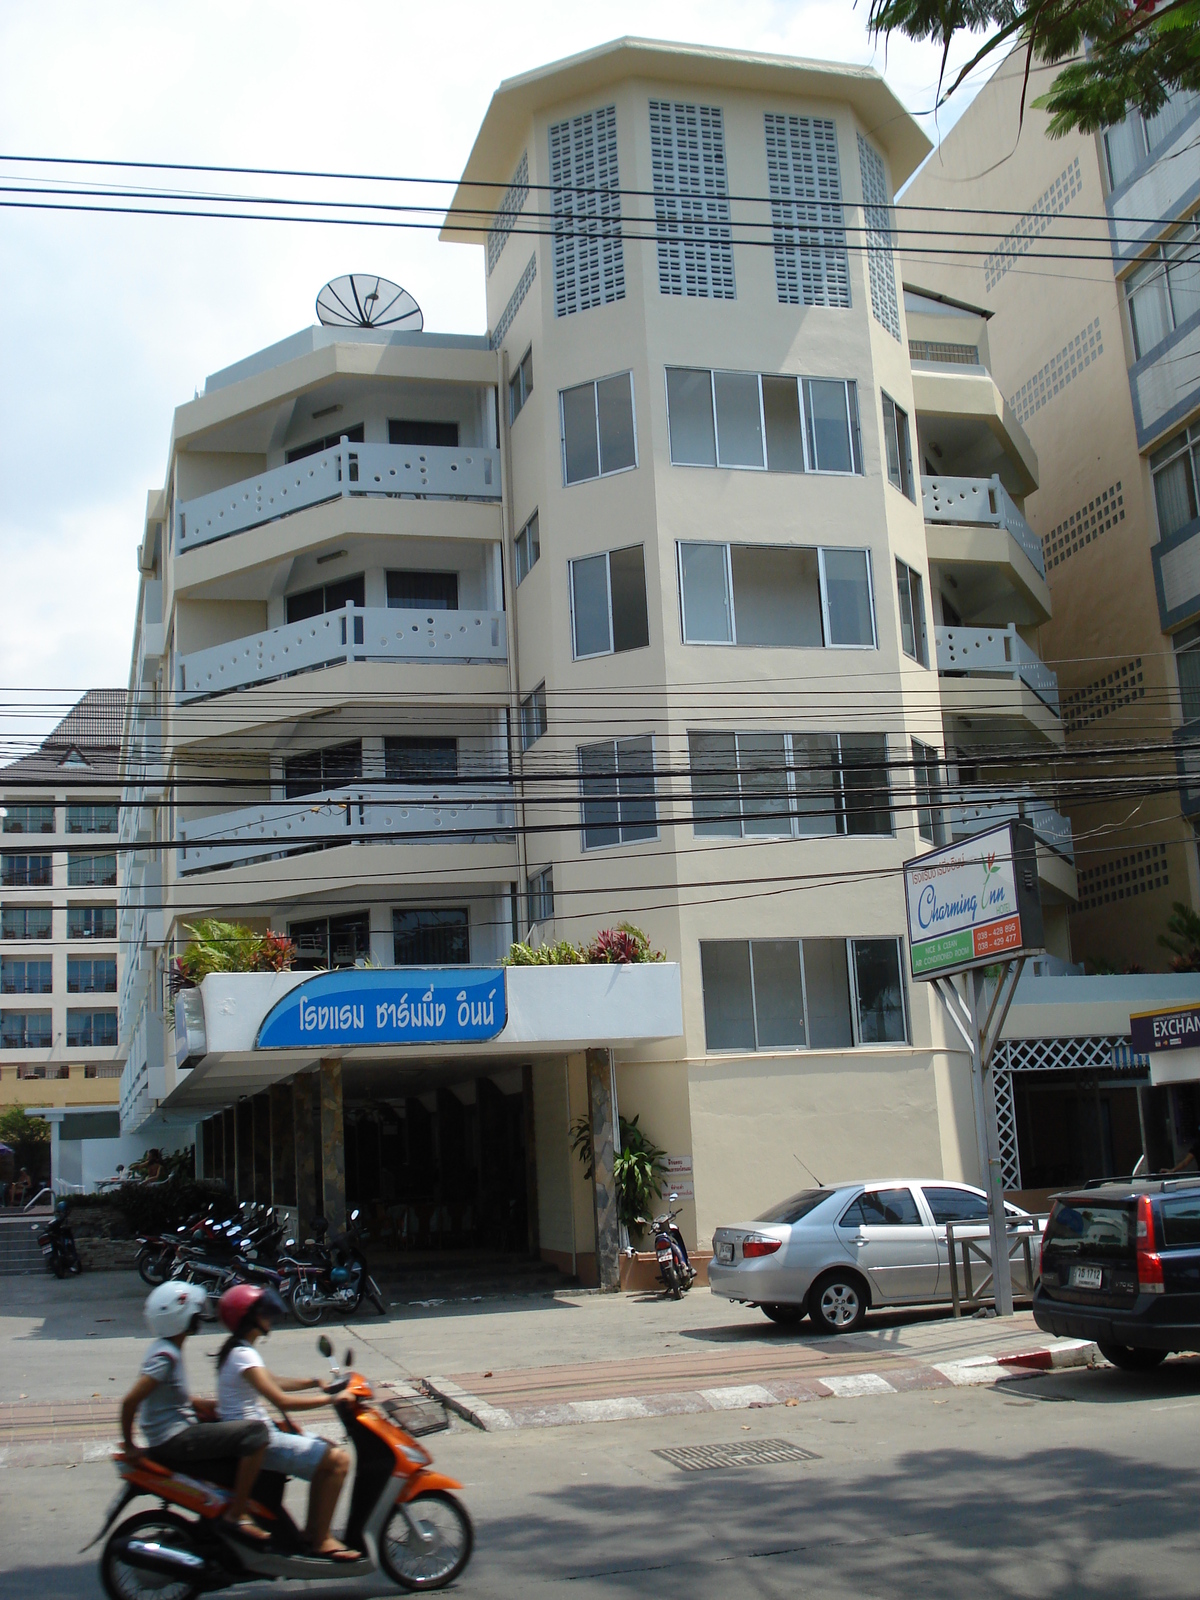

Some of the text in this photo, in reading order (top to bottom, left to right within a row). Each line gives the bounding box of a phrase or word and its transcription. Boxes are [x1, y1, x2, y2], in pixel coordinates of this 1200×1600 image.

[918, 873, 1006, 929] Charming Inn
[996, 902, 1011, 915] HOTEL
[977, 931, 988, 941] 038
[993, 926, 1004, 936] 428
[925, 945, 936, 954] NICE
[942, 940, 958, 950] CLEAN
[977, 941, 988, 951] 038
[993, 937, 1004, 946] 429
[1005, 933, 1017, 943] 477
[915, 946, 970, 967] AIR CONDITIONED ROOM
[300, 984, 496, 1031] โรงแรม ชาร์มมิ่ง อินน์
[1087, 1268, 1100, 1280] 1712
